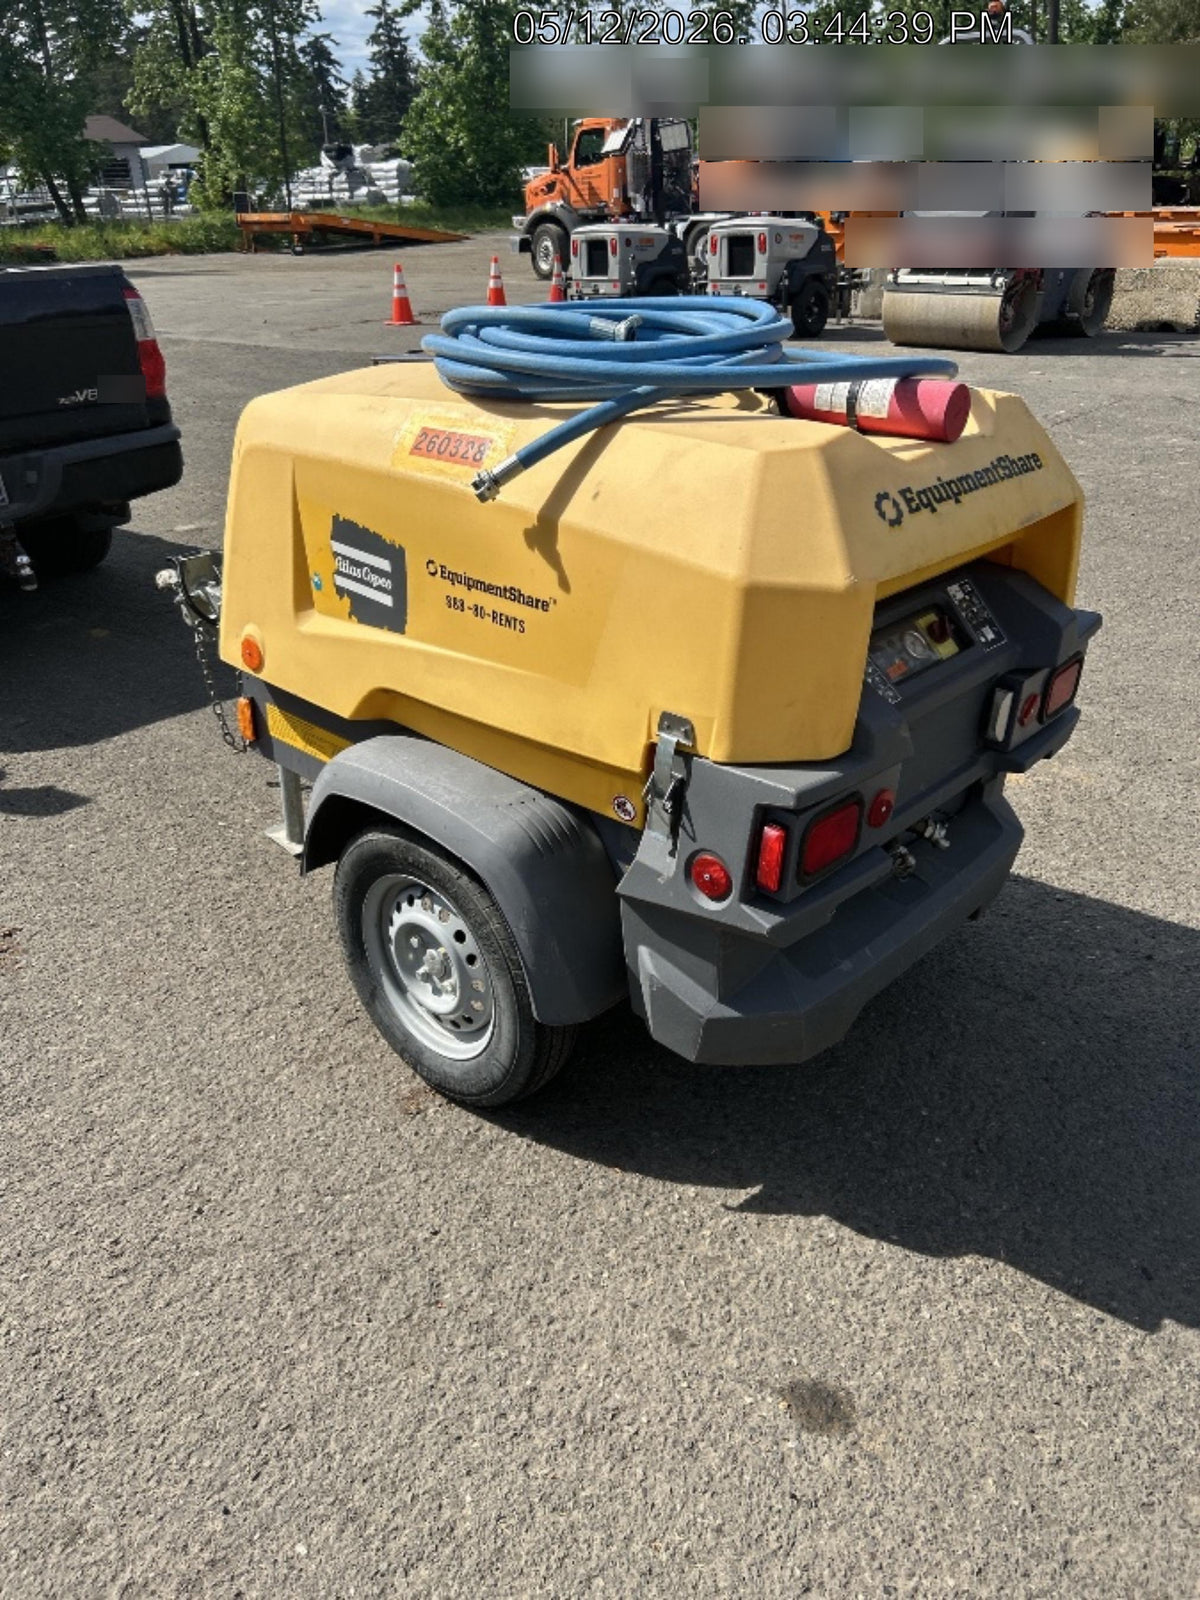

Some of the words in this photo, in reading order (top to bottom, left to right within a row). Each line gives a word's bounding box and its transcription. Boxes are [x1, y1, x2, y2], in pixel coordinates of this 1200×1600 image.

[413, 431, 487, 463] 260328
[898, 452, 1043, 514] EquipmentShare
[335, 556, 362, 579] Atlas
[439, 564, 550, 612] EquipmentShare
